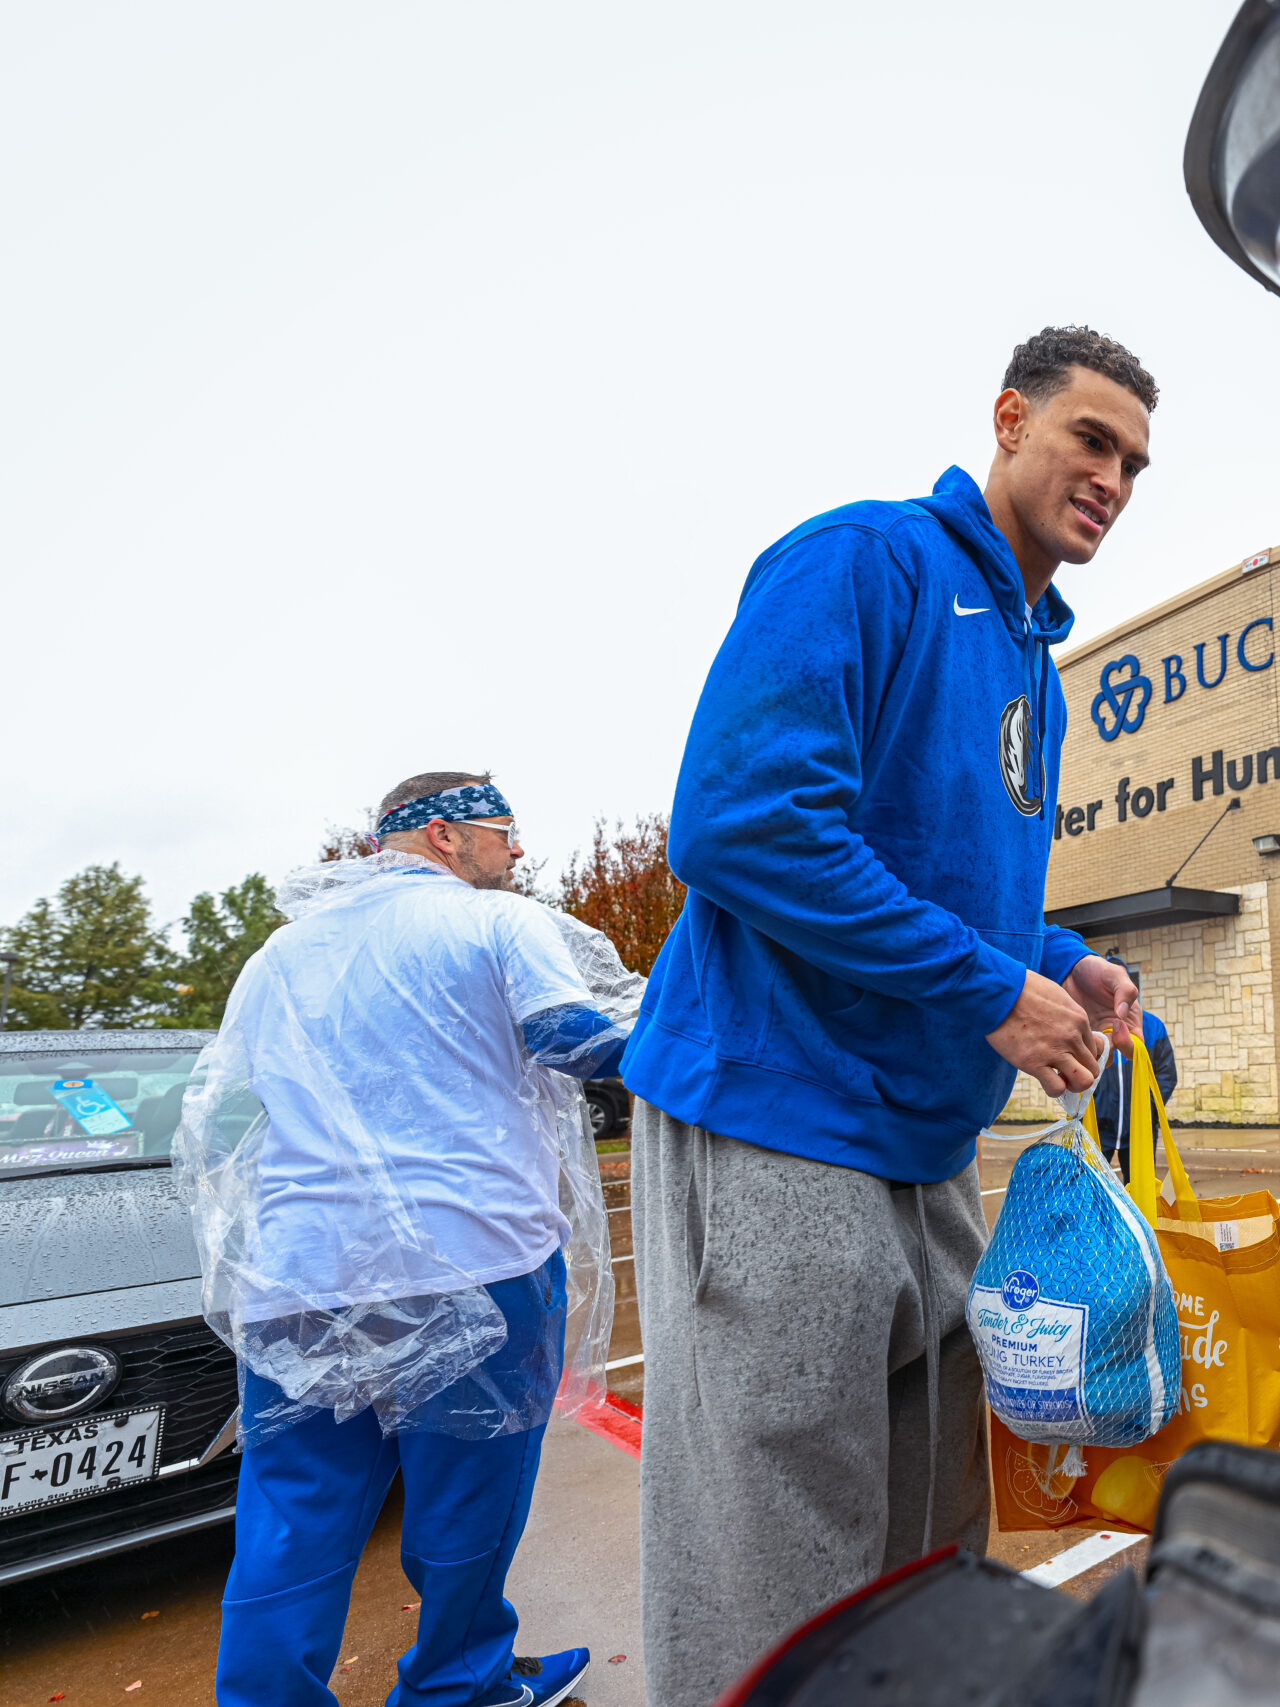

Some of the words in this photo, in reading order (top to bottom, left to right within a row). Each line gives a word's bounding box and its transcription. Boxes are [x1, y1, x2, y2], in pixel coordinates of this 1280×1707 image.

[1115, 776, 1175, 823] for
[1003, 1276, 1038, 1303] Kroger
[977, 1308, 1011, 1336] Tender
[1011, 1313, 1029, 1334] &
[1025, 1317, 1073, 1343] Juicy
[991, 1334, 1038, 1352] PREMIUM
[1012, 1353, 1066, 1368] TURKEY
[18, 1370, 106, 1397] NISSAN
[13, 1424, 100, 1454] TEXAS
[50, 1434, 147, 1488] 0424
[18, 1497, 44, 1508] Lone
[47, 1490, 70, 1502] Star
[72, 1484, 100, 1495] State
